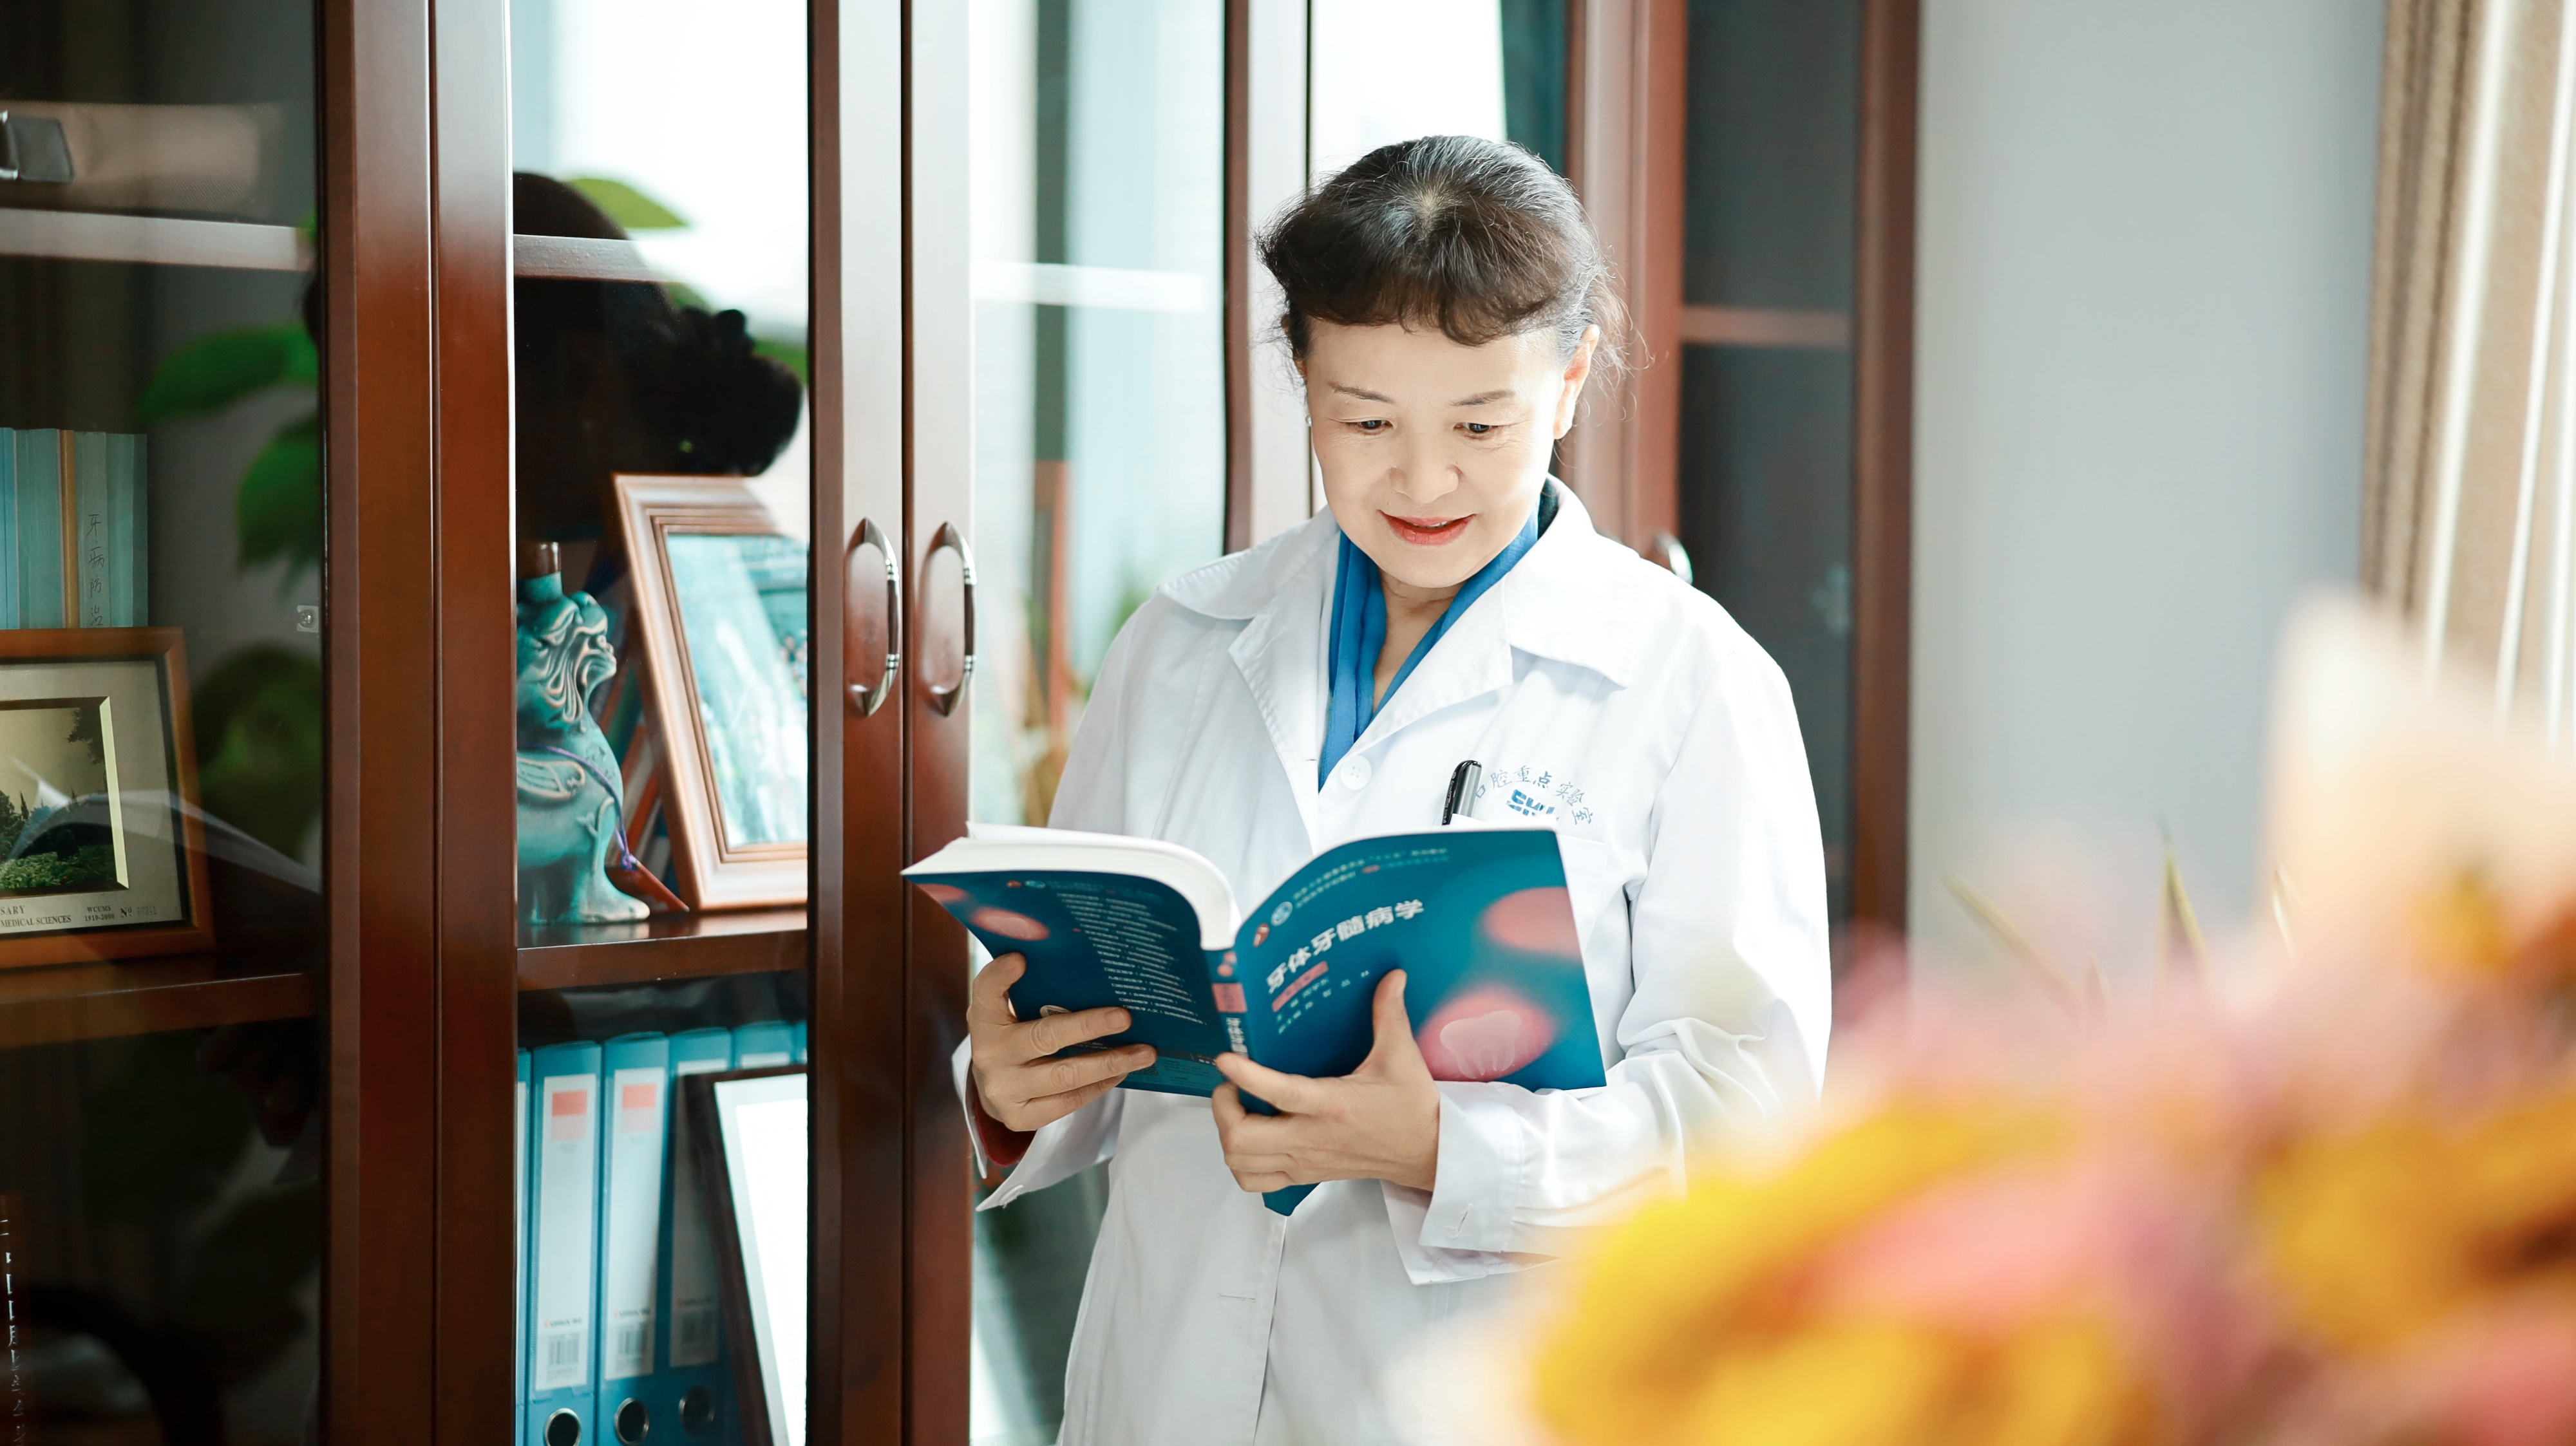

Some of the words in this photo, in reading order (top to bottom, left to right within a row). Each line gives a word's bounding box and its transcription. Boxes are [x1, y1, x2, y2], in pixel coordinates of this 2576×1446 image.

[86, 514, 104, 626] 牙病防治
[1, 905, 25, 915] SARY
[1, 917, 35, 928] MEDICAL
[36, 915, 71, 925] SCIENCES
[1266, 899, 1425, 994] 牙体牙髓病学
